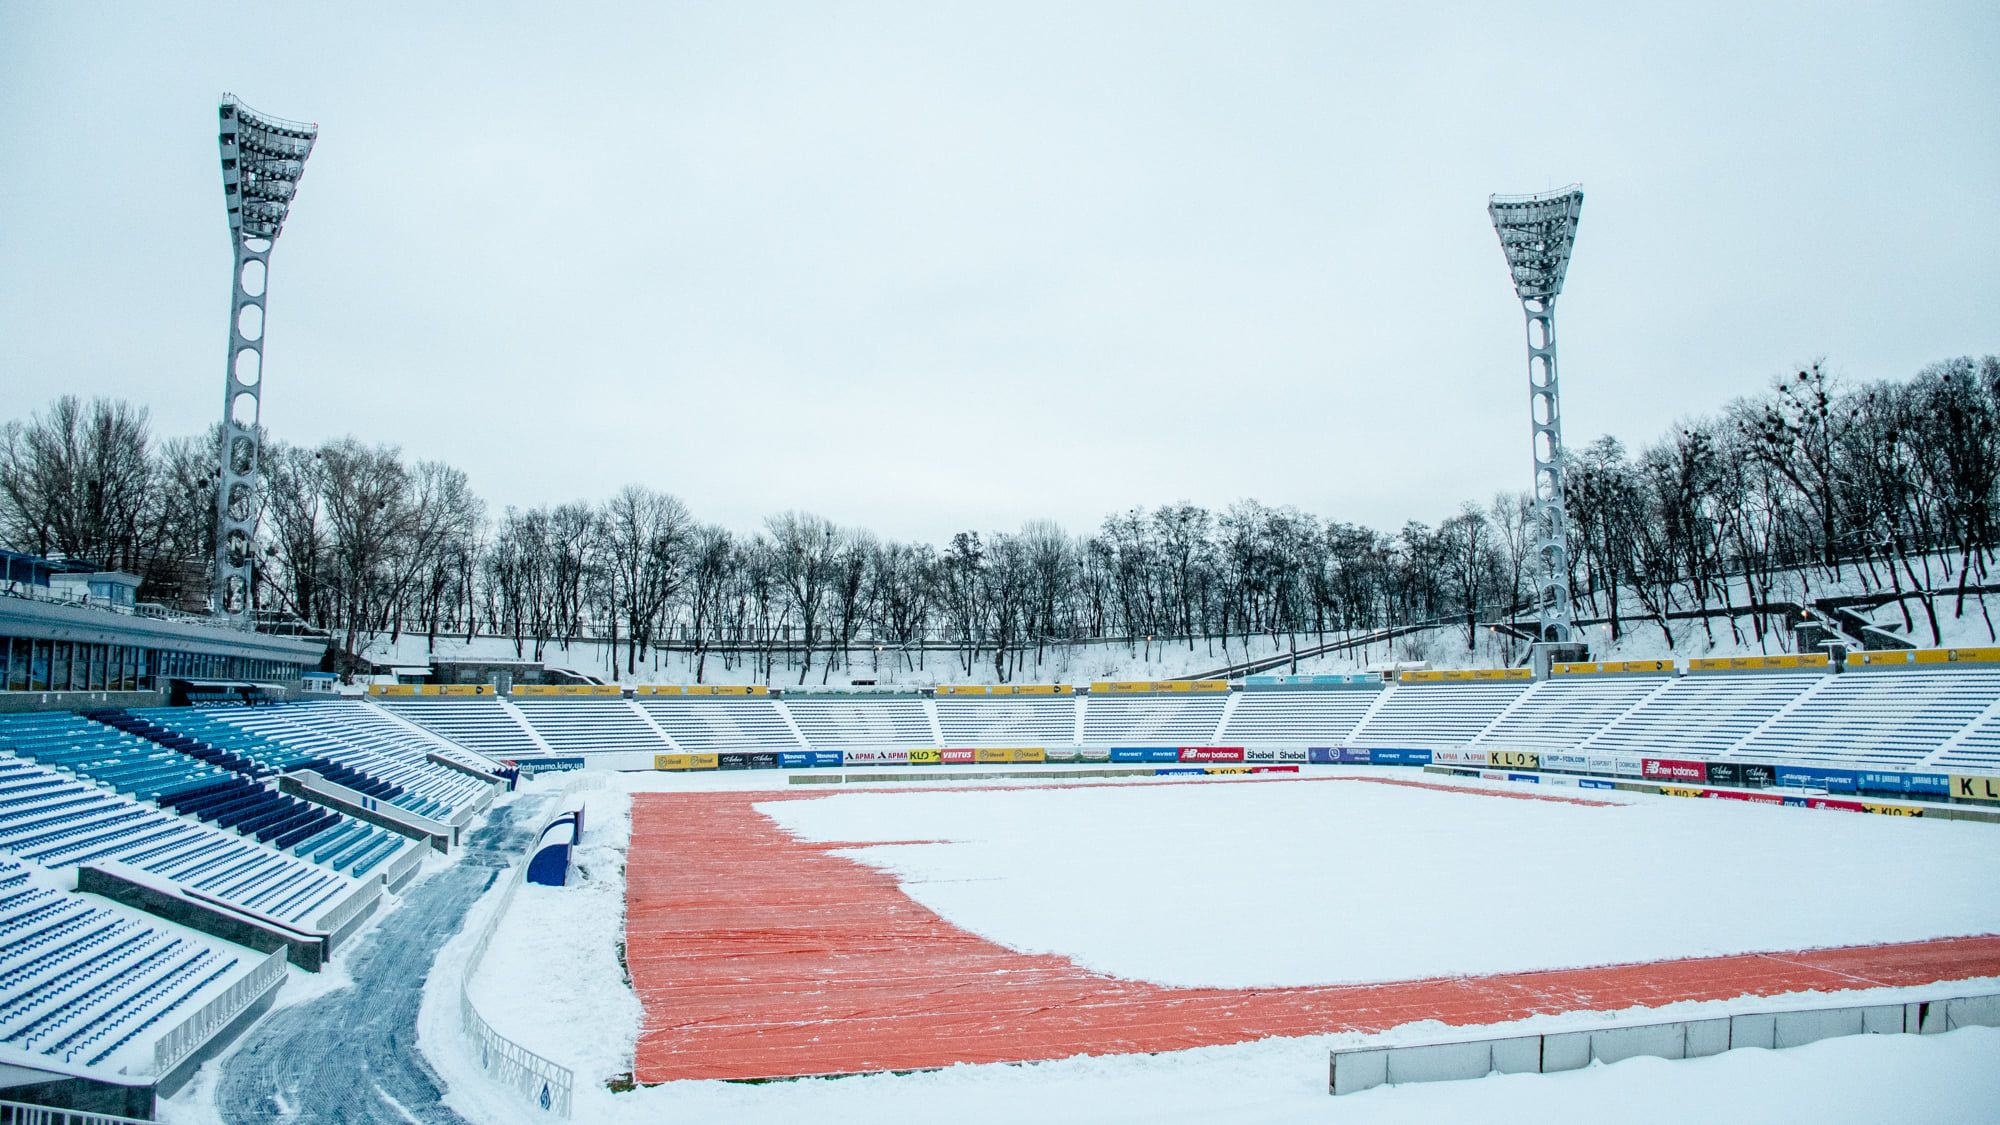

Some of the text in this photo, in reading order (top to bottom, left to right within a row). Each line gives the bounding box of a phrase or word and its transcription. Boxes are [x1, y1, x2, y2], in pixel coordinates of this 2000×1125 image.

[910, 751, 929, 760] KLO
[943, 751, 972, 759] VENTUS
[519, 761, 583, 771] fcdynamo.kiev.ua
[1659, 766, 1672, 774] new
[1672, 766, 1699, 776] balance
